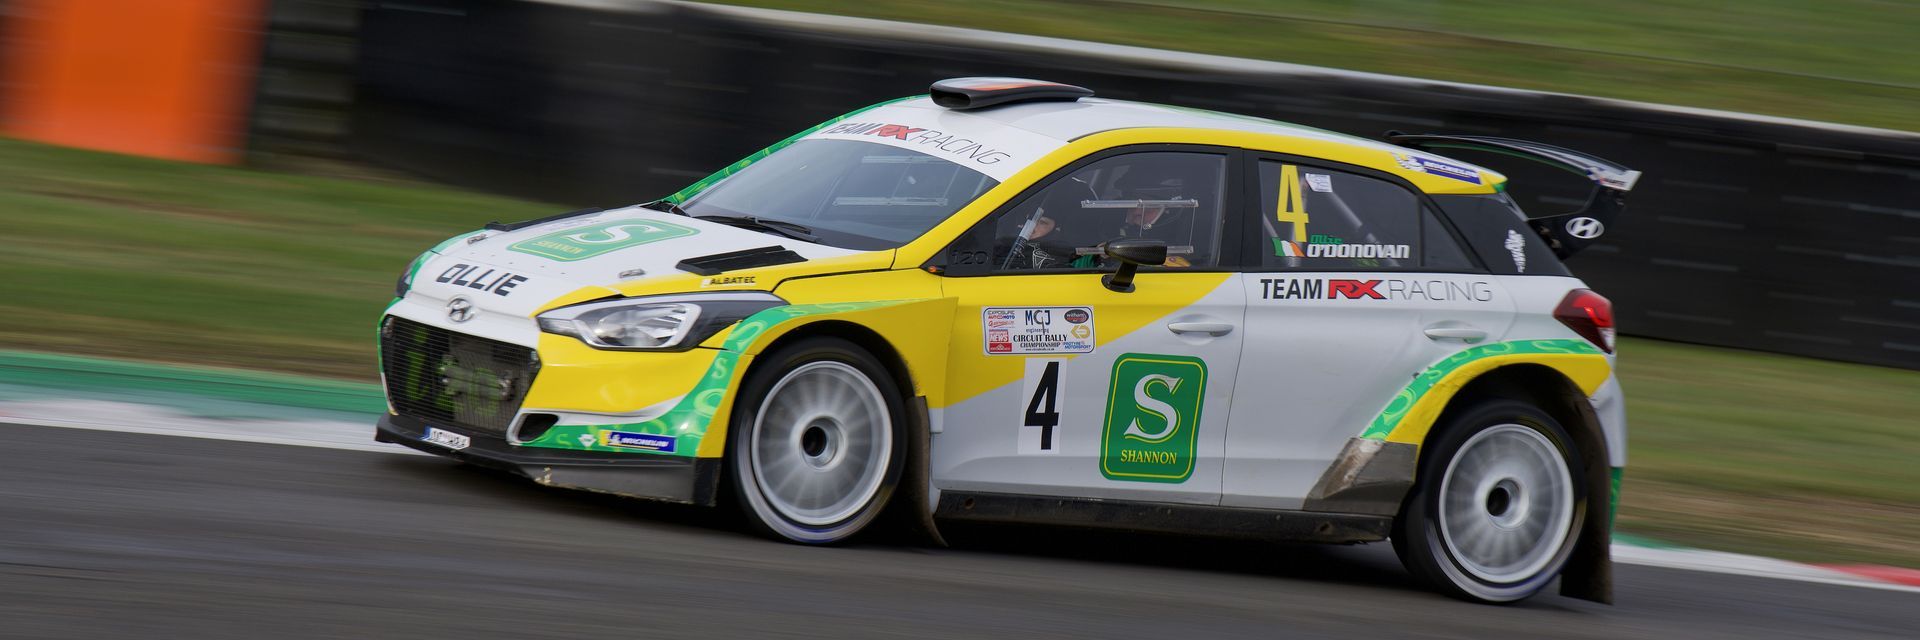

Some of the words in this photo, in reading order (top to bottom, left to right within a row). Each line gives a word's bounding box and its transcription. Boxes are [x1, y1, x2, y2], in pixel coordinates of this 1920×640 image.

[864, 123, 927, 141] RX
[910, 131, 1011, 165] RACING
[1277, 164, 1309, 243] 4
[1306, 243, 1410, 259] O'DONOVAN
[436, 263, 528, 297] OLLIE
[710, 276, 756, 285] ALBATEC
[1260, 279, 1322, 299] TEAM
[1328, 279, 1387, 300] RX
[1389, 279, 1493, 302] RACING
[1045, 334, 1067, 342] RALLY
[1024, 361, 1060, 450] 4
[1124, 374, 1184, 444] S
[1120, 450, 1177, 465] SHANNON
